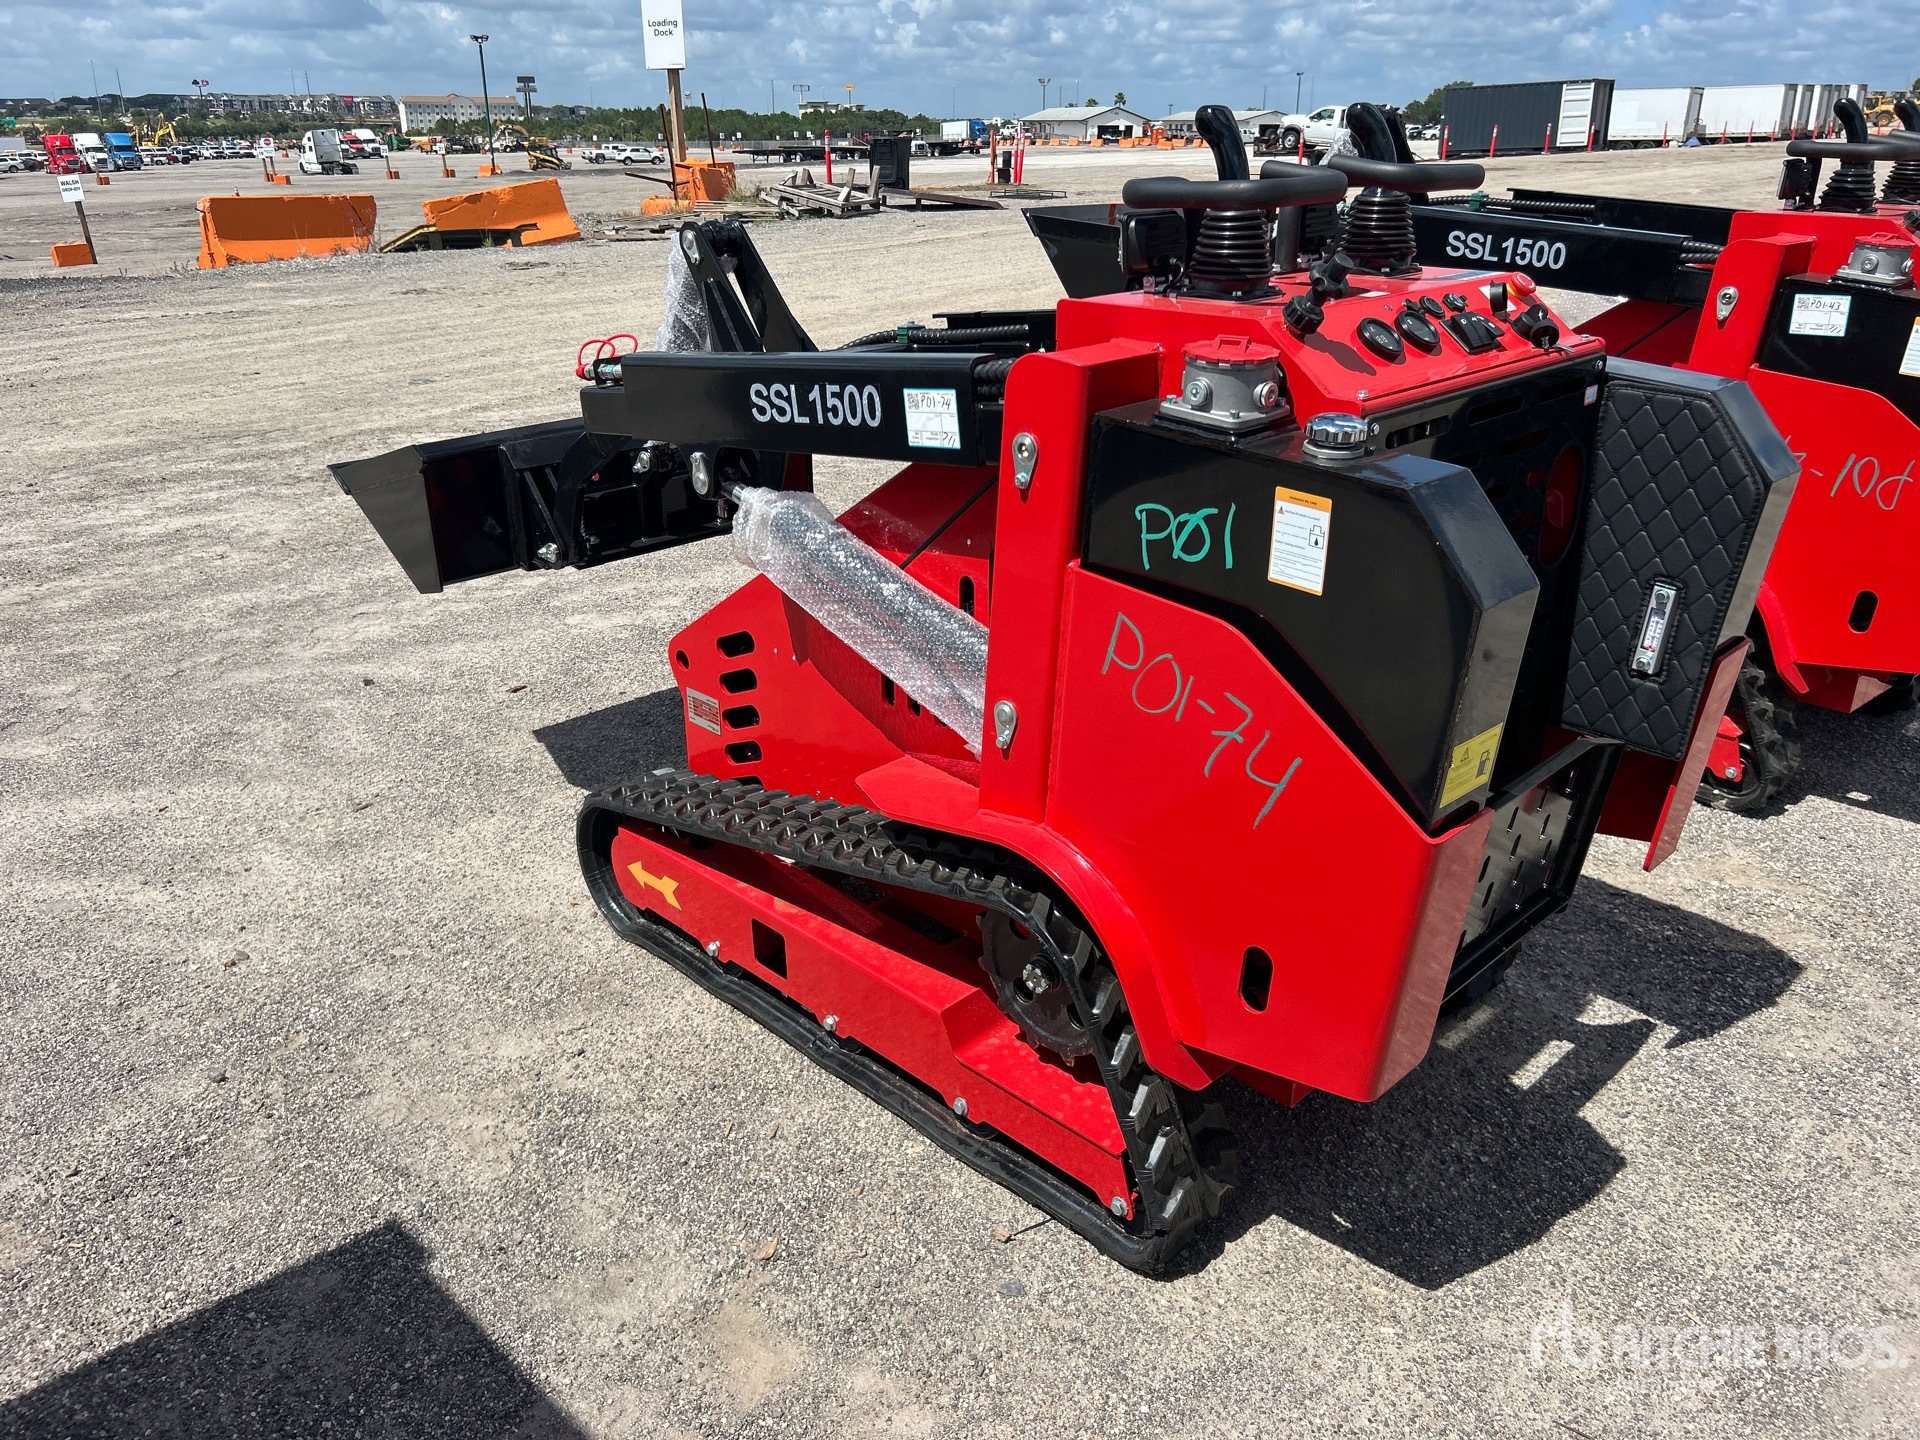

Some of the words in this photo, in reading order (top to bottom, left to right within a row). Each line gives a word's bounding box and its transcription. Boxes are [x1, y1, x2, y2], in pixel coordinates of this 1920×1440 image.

[648, 19, 678, 28] Loading
[653, 28, 674, 37] Dock
[1445, 231, 1567, 271] SSL1500
[749, 382, 882, 428] SSL1500
